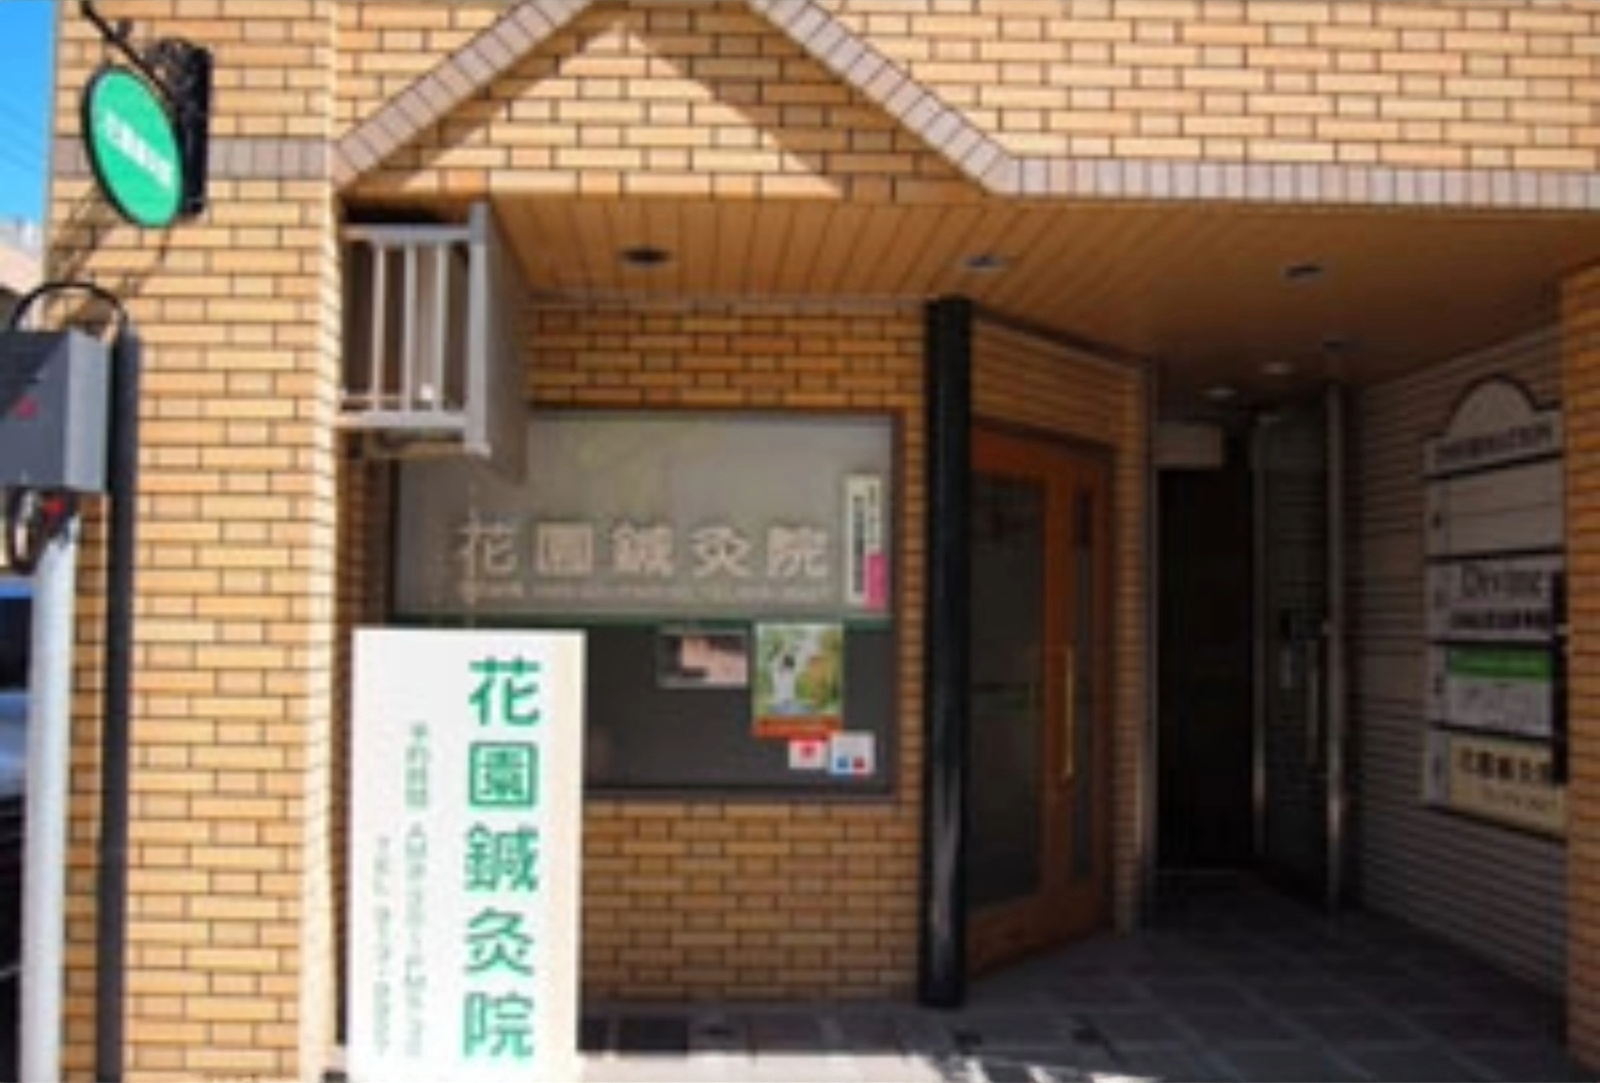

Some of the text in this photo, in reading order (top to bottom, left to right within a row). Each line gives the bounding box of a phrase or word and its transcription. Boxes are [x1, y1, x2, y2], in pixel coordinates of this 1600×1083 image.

[457, 517, 829, 578] 花園鍼灸院
[463, 655, 541, 1059] 花園鍼灸院
